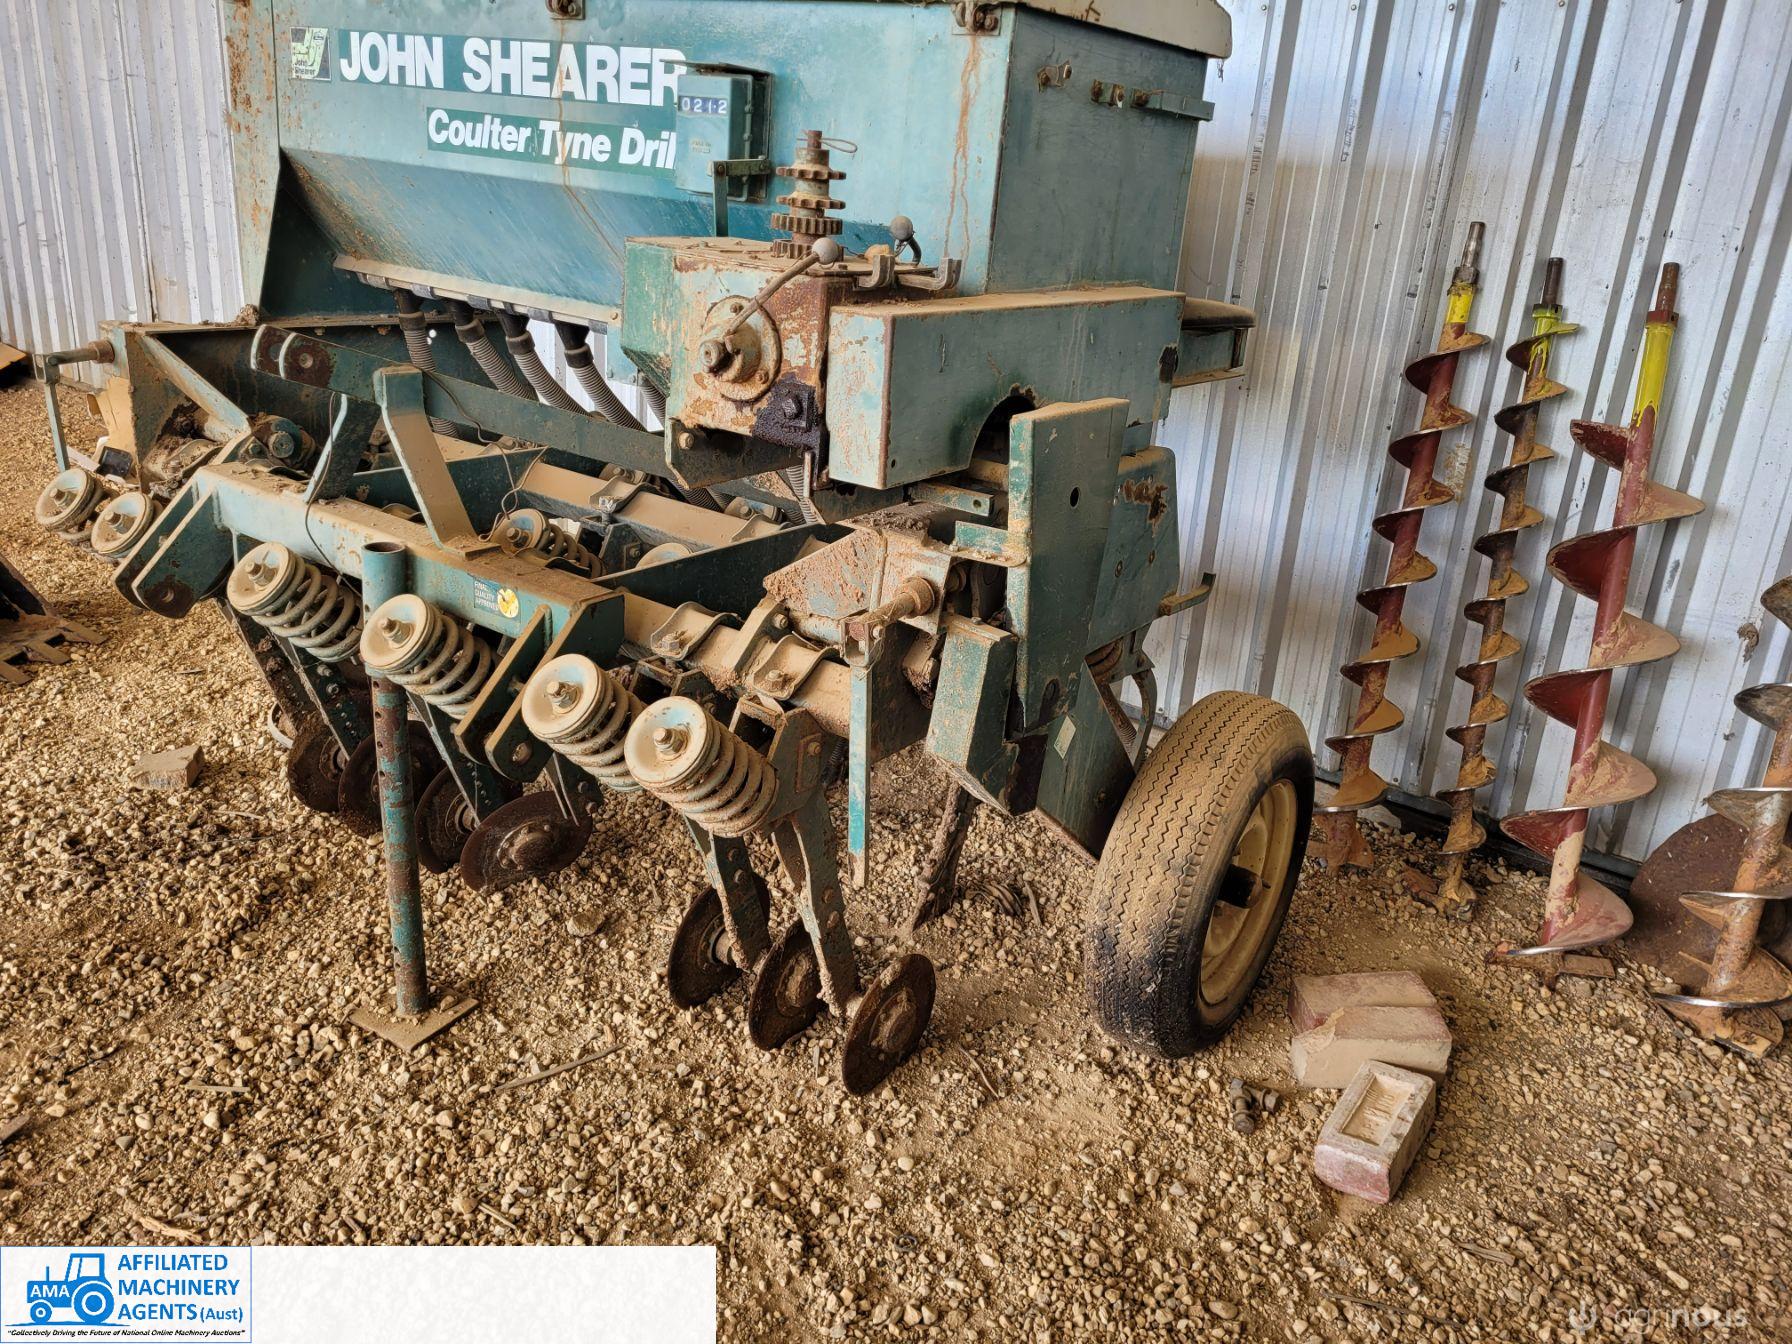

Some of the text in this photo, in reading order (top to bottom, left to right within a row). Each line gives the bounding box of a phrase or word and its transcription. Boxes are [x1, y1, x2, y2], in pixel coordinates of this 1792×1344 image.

[340, 31, 688, 107] JOHN SHEARER
[428, 109, 677, 170] Coulter Tyne Dril
